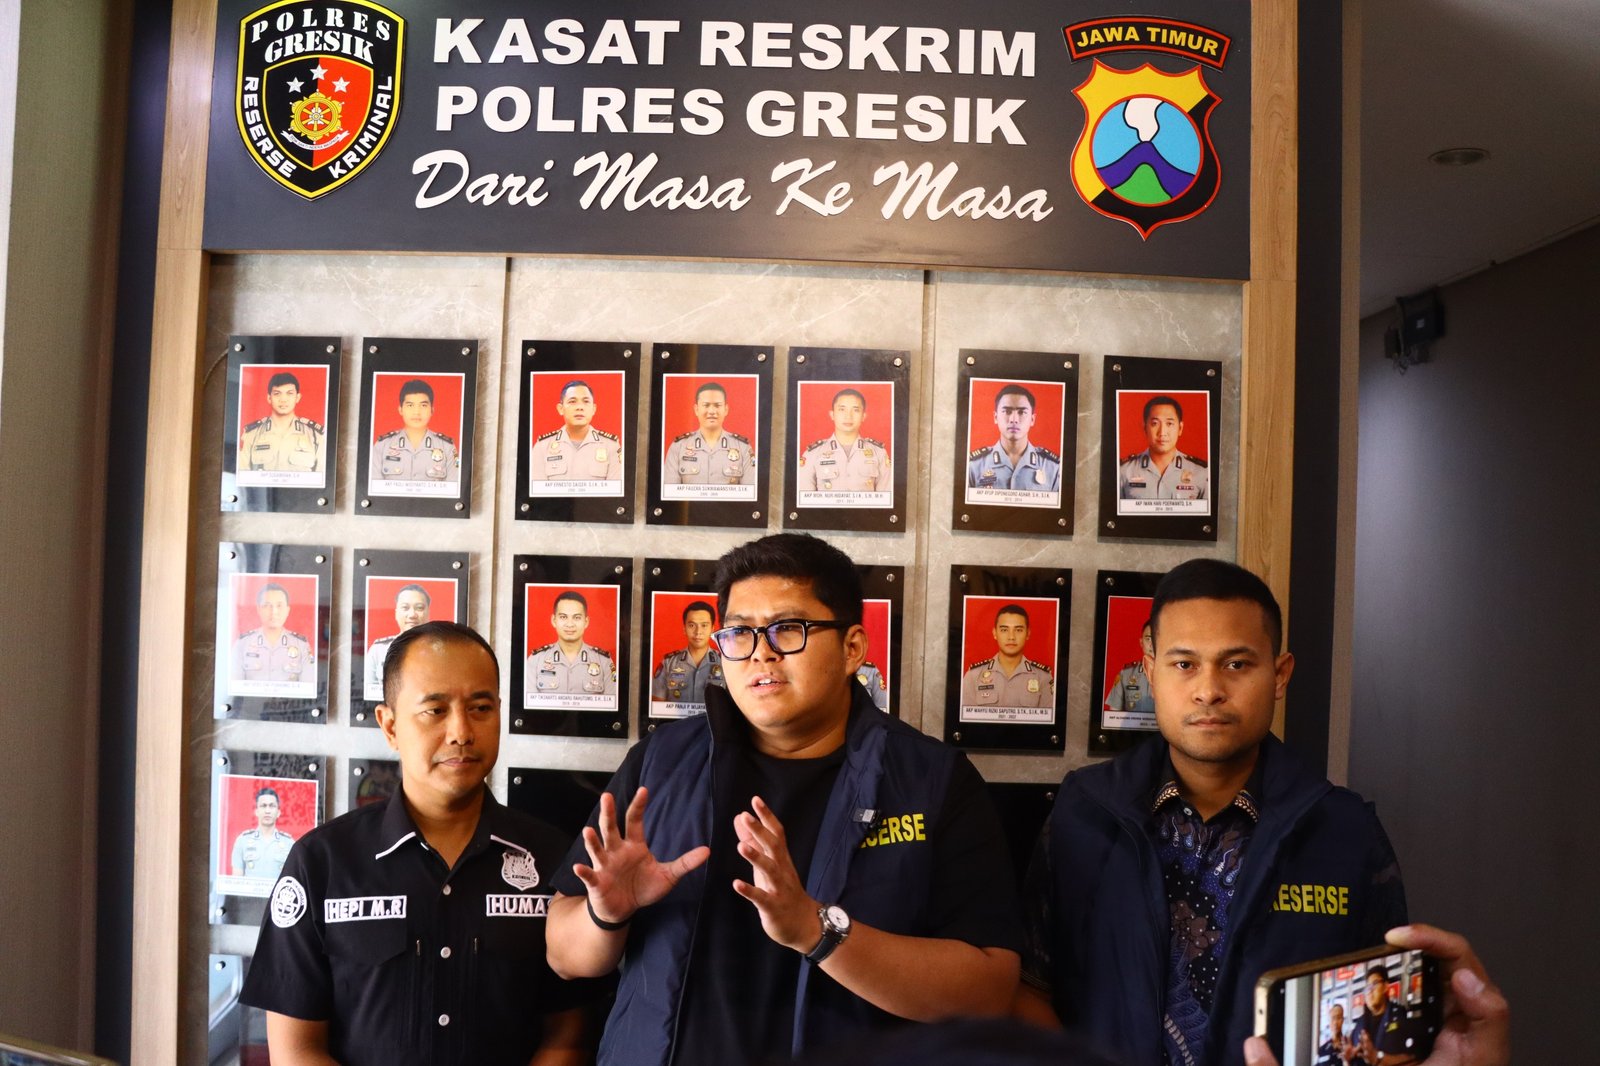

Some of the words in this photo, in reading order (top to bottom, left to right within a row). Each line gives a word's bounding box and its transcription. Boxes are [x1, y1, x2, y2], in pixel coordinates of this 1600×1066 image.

[251, 8, 390, 43] POLRES
[1077, 27, 1139, 47] JAWA
[1147, 27, 1219, 56] TIMUR
[264, 30, 374, 65] GRESIK
[434, 18, 679, 65] KASAT
[700, 21, 1035, 77] RESKRIM
[244, 76, 297, 178] RESERSE
[328, 76, 392, 178] KRIMINAL
[436, 86, 723, 135] POLRES
[746, 91, 1026, 145] GRESIK
[412, 150, 554, 209] Dari
[573, 151, 751, 211] Masa
[771, 158, 853, 216] Ke
[873, 161, 1053, 221] Masa
[329, 900, 364, 919] HEPI
[370, 898, 402, 917] M.R
[491, 897, 552, 914] HUMA
[1273, 884, 1348, 915] ESERSE
